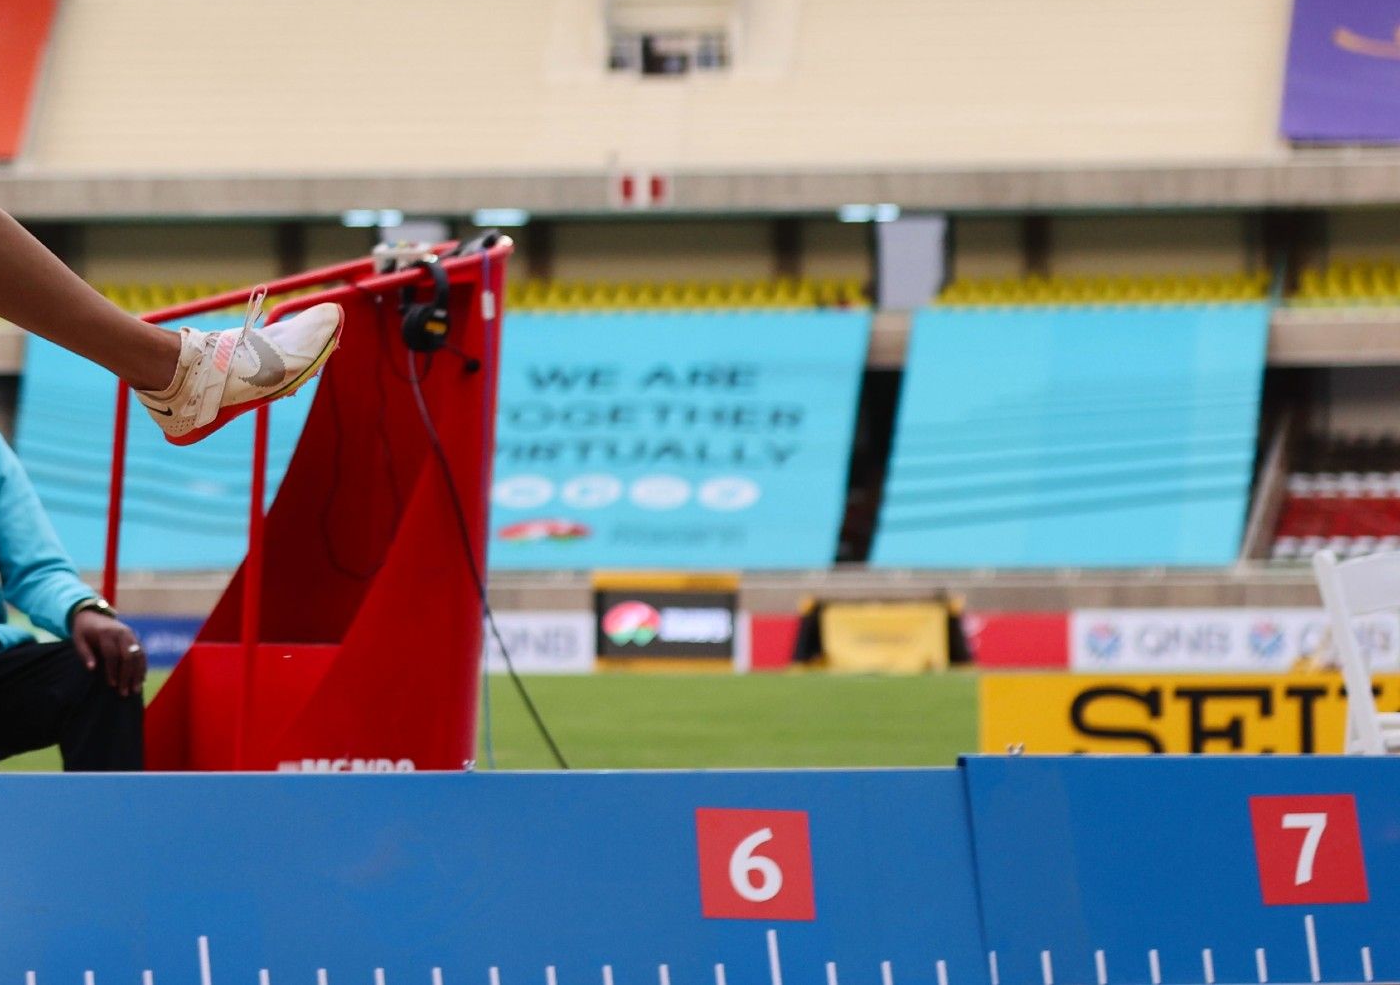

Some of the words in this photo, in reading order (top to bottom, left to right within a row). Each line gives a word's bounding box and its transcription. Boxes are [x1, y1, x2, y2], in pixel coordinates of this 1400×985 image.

[526, 365, 618, 392] WE
[640, 365, 758, 392] ARE
[498, 402, 804, 431] OGETHER
[1132, 625, 1234, 656] QNB
[1069, 684, 1400, 755] SEI
[729, 827, 784, 903] 6
[1281, 812, 1328, 886] 7
